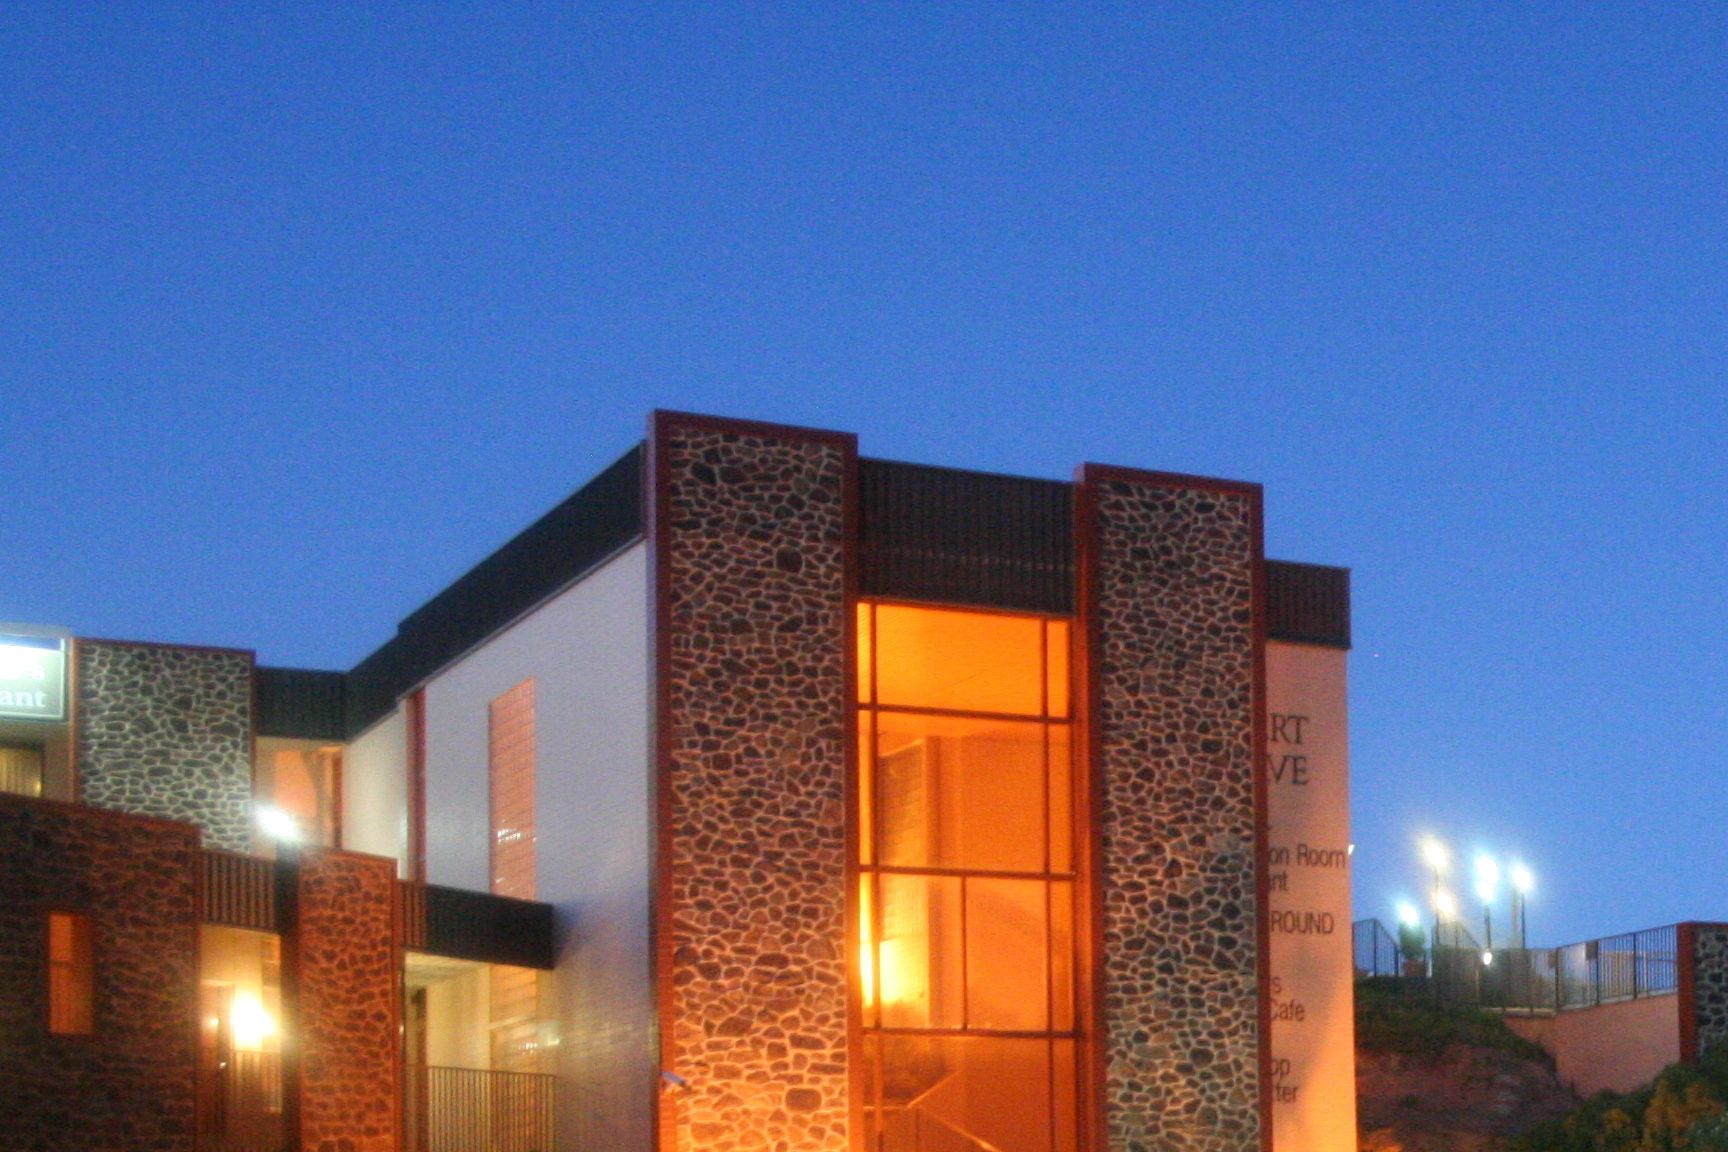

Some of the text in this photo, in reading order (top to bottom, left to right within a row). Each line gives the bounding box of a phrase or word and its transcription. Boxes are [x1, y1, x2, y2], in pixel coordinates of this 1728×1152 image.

[1271, 712, 1310, 745] RT
[1296, 843, 1346, 869] Room
[1270, 911, 1335, 935] ROUND
